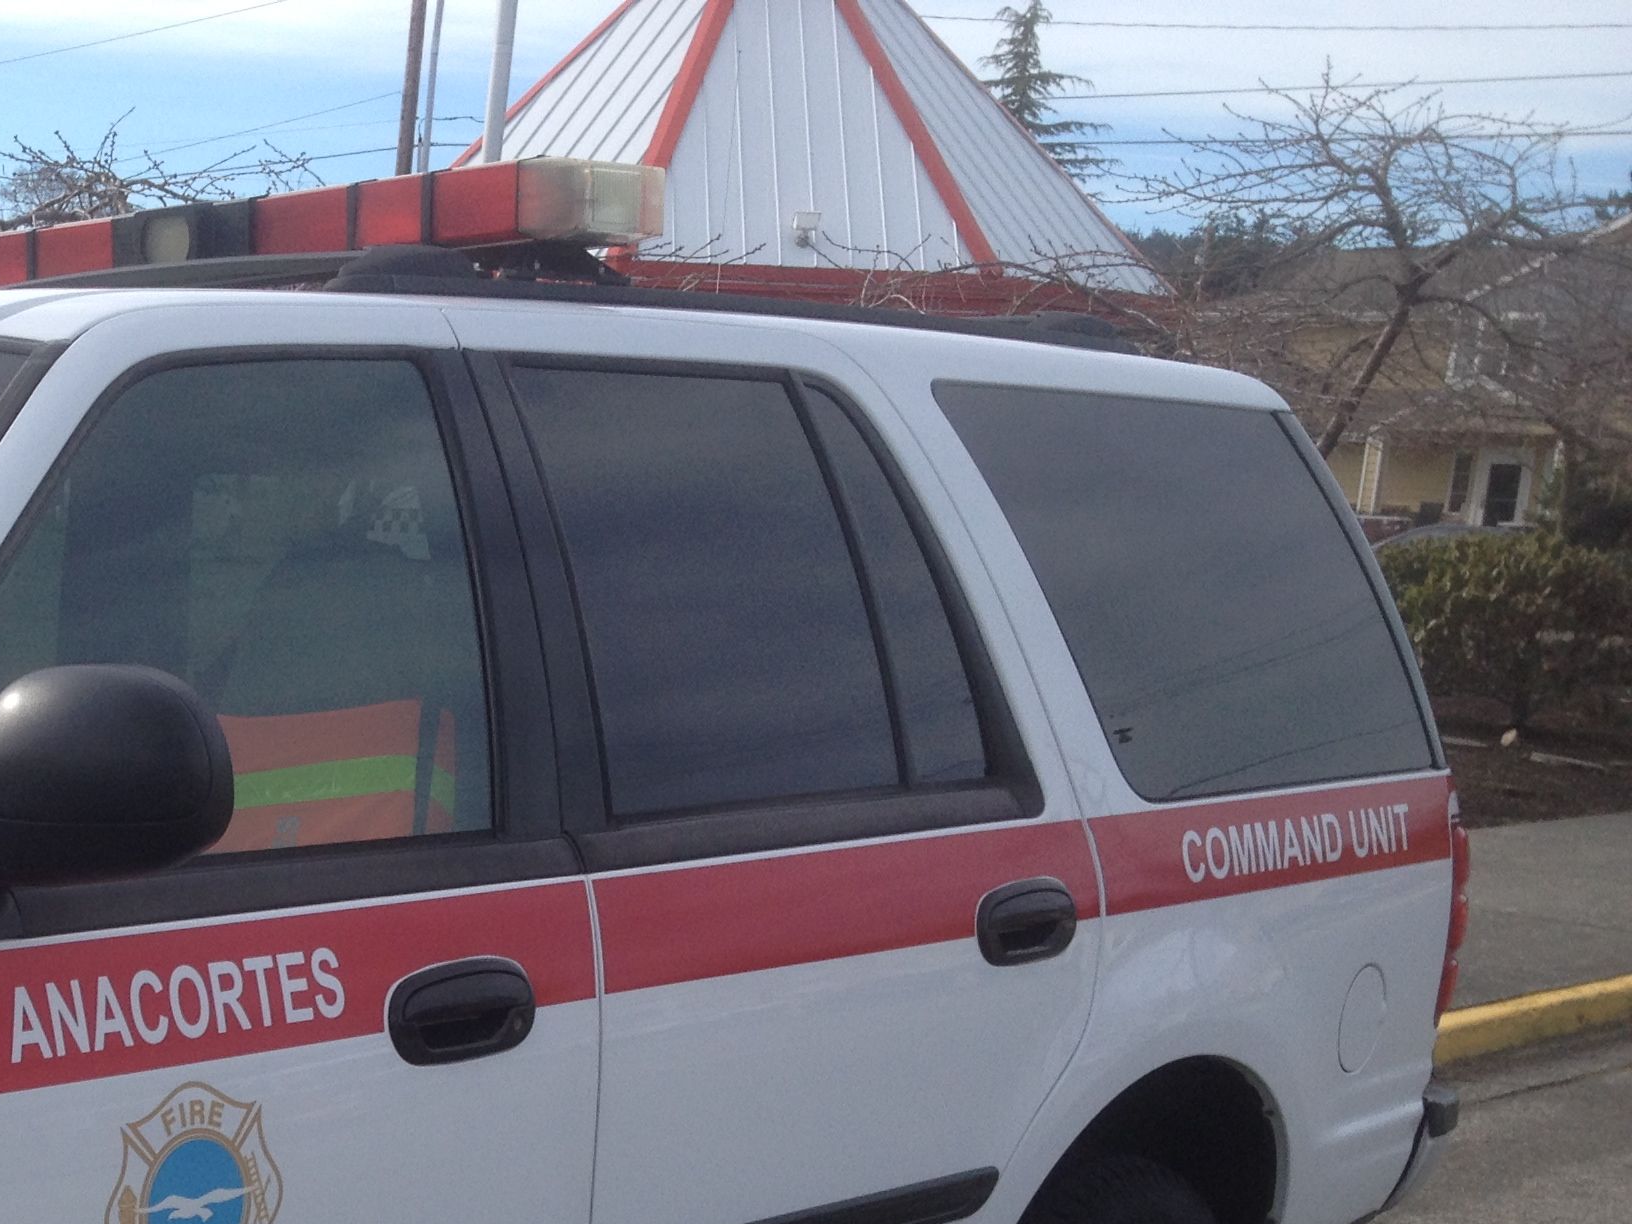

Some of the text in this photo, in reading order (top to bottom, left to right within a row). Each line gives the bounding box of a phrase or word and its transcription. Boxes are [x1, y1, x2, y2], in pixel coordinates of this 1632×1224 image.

[1182, 803, 1409, 883] COMMAND UNIT
[11, 947, 345, 1064] ANACORTES
[160, 1099, 225, 1136] FIRE
